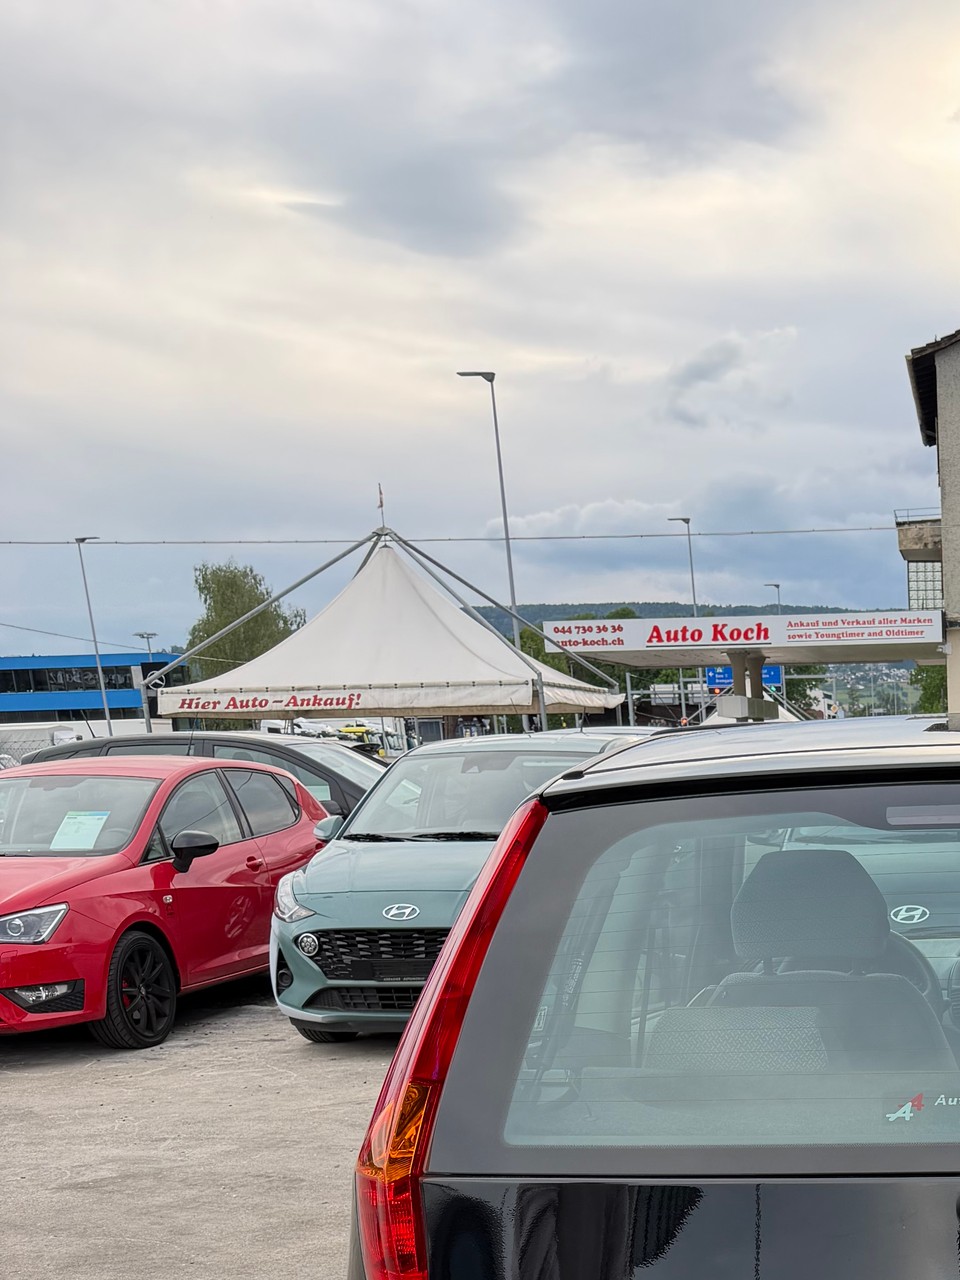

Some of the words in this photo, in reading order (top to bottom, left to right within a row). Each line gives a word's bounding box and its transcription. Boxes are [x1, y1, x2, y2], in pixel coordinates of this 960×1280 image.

[786, 620, 819, 628] Ankauf
[822, 619, 838, 627] und
[841, 618, 876, 627] Verkauf
[878, 617, 898, 625] aller
[900, 617, 933, 625] Marken
[553, 626, 572, 634] 044
[574, 625, 593, 634] 730
[595, 624, 608, 634] 36
[610, 624, 623, 633] 36
[646, 625, 703, 643] Auto
[711, 622, 769, 642] Koch
[814, 631, 865, 640] Youngtimer
[885, 629, 925, 638] Oldtimer
[555, 637, 624, 647] uto-koch.ch
[178, 697, 220, 710] Hier
[224, 696, 269, 710] Auto
